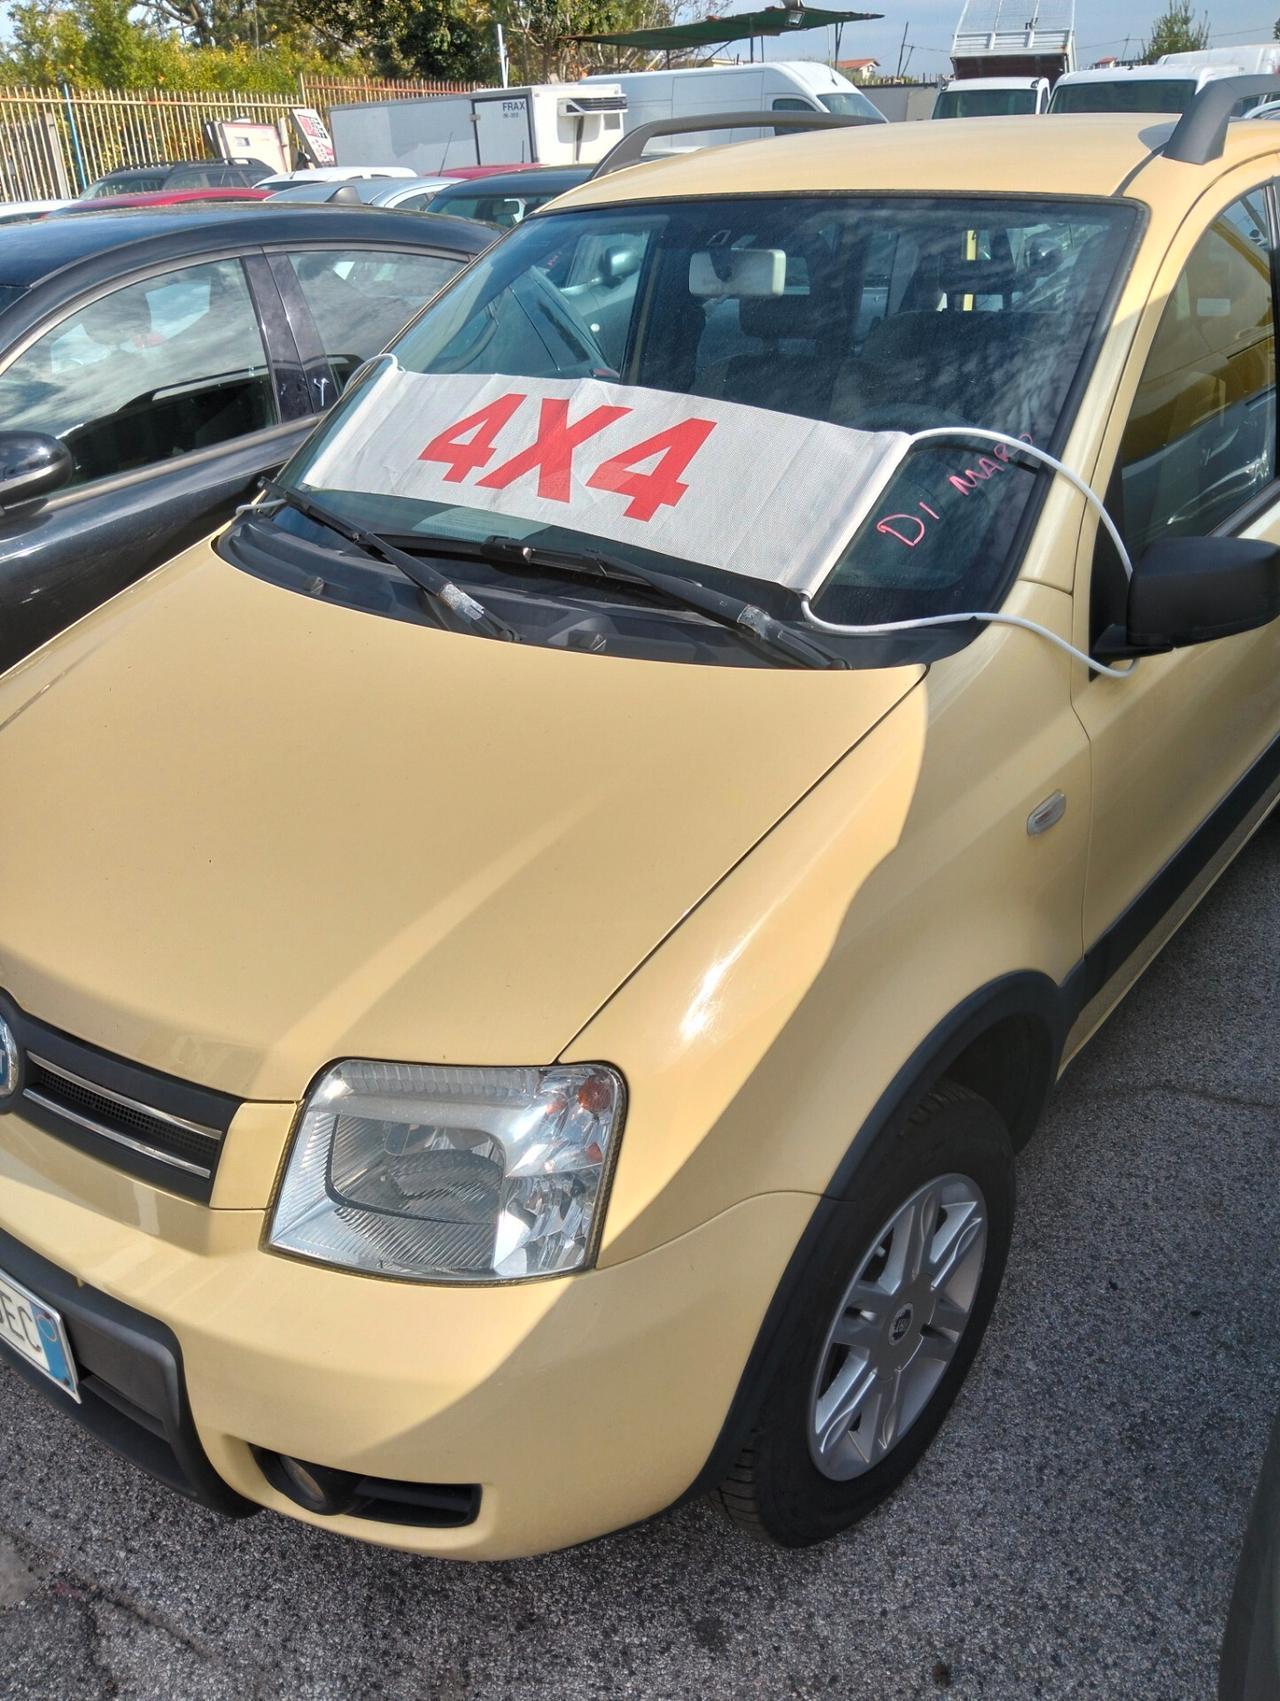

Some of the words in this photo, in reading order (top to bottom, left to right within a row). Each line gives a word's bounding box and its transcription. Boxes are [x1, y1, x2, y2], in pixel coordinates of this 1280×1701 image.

[502, 101, 526, 111] FRAX
[417, 393, 718, 523] 4X4
[876, 501, 940, 547] DI
[949, 432, 1034, 496] MAR
[0, 1290, 42, 1353] EC
